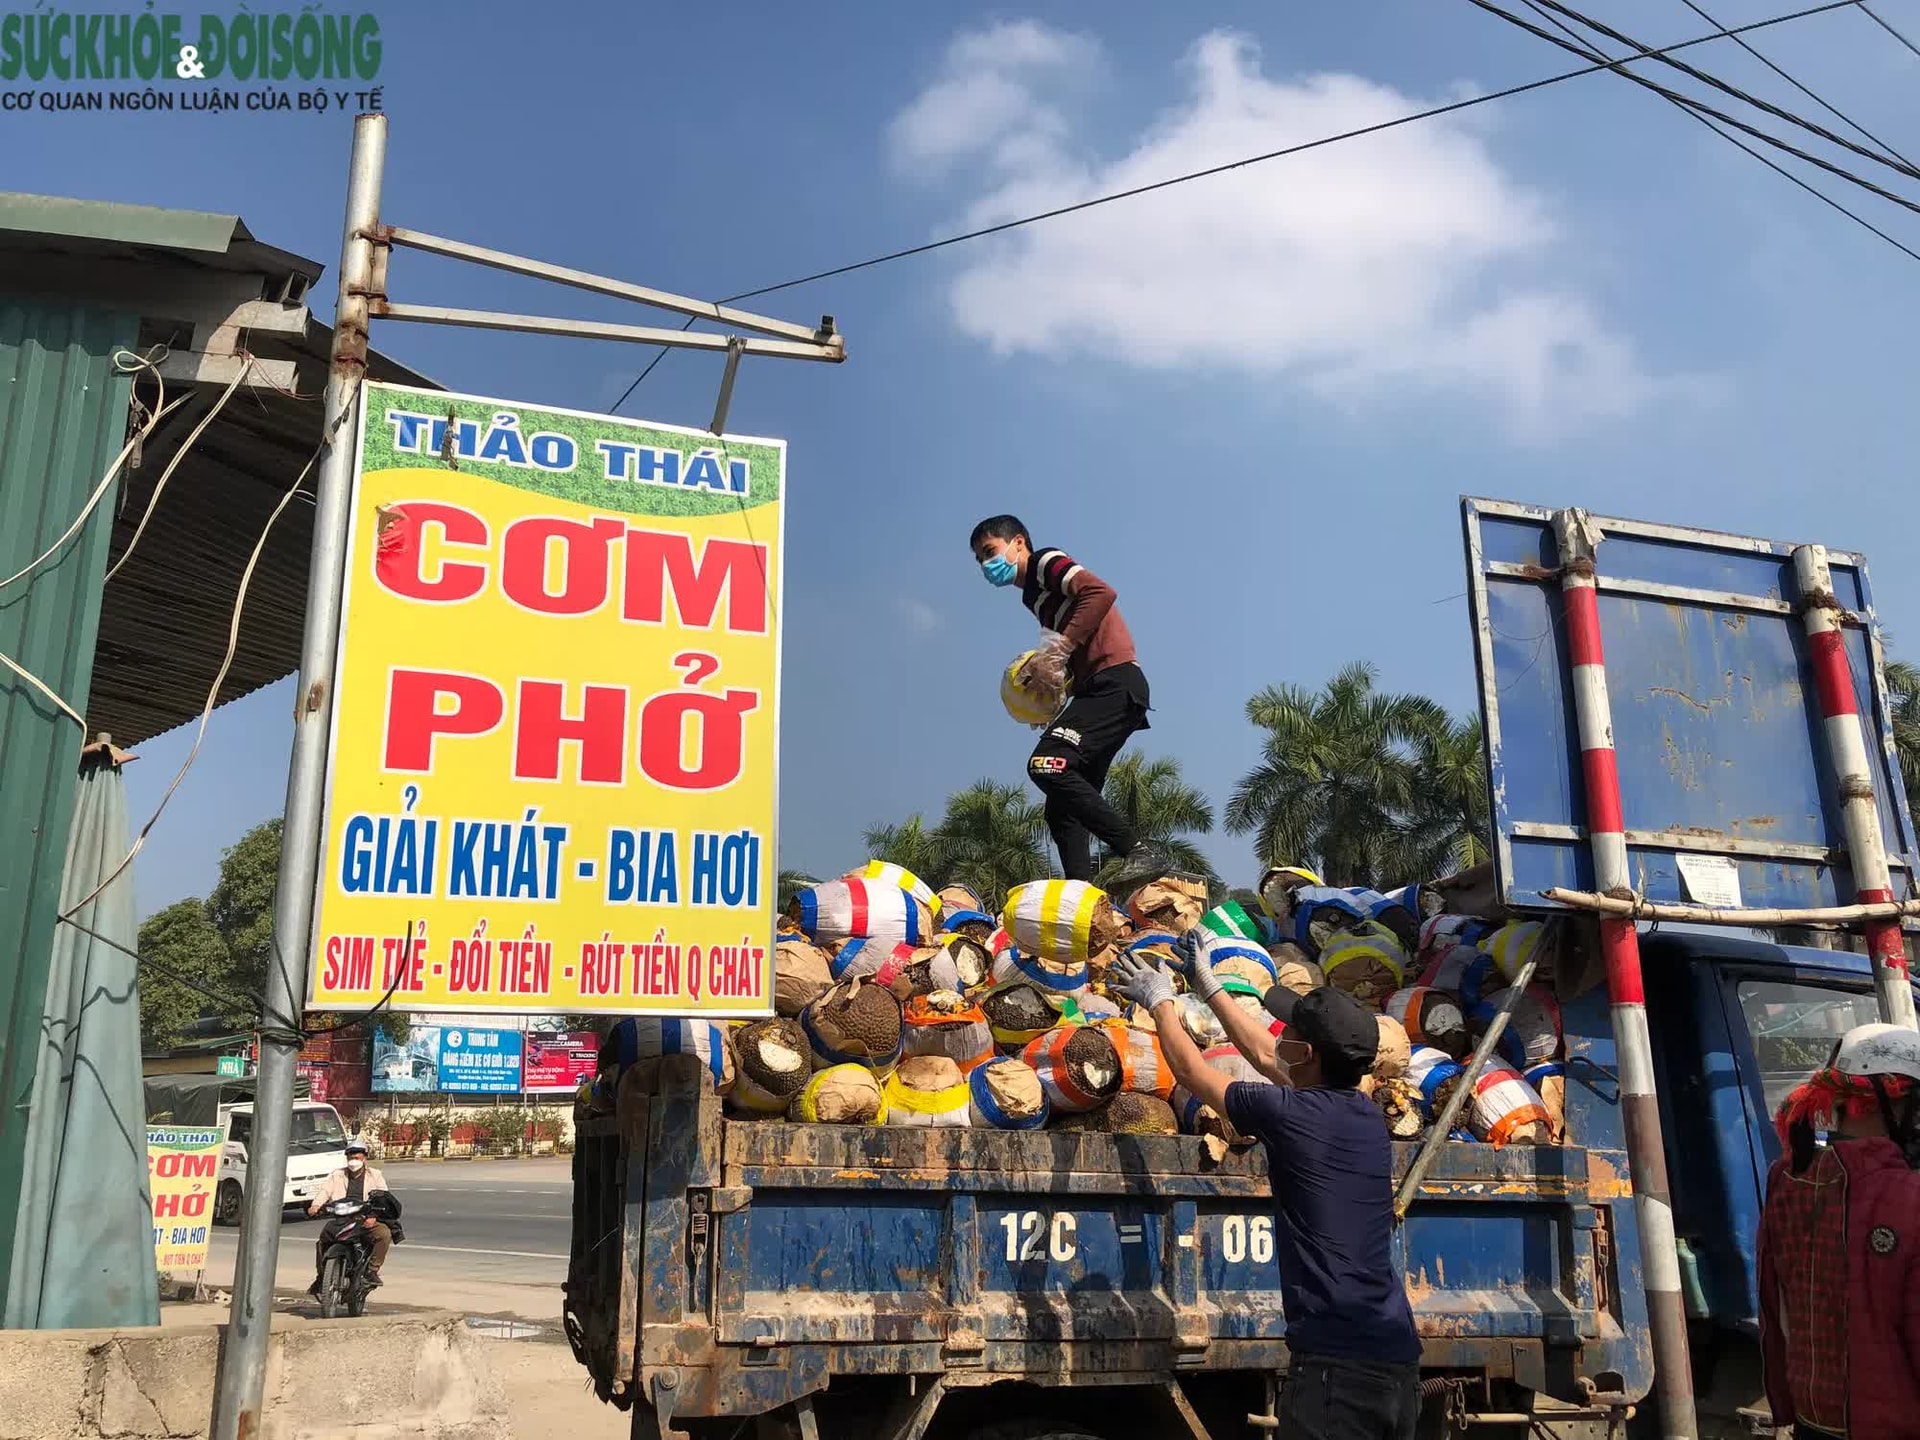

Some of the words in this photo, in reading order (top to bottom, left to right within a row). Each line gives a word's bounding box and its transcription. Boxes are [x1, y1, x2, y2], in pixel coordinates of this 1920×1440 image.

[388, 413, 577, 471] THẢO
[598, 443, 748, 494] THÁI
[375, 501, 768, 634] CƠM
[384, 652, 758, 789] PHỞ
[342, 785, 437, 895] GIẢI
[450, 809, 567, 899] KHÁT
[608, 829, 678, 903] BIA
[692, 830, 759, 906] HƠI
[324, 936, 375, 990] SIM
[382, 920, 427, 991] THẺ
[449, 919, 492, 992] ĐỔI
[499, 924, 551, 993] TIỀN
[580, 932, 625, 994] RÚT
[631, 928, 681, 995] TIỀN
[687, 945, 701, 1001] Q
[709, 936, 764, 997] CHÁT
[182, 1130, 215, 1143] THÁI
[153, 1183, 210, 1218] HỞ
[171, 1227, 187, 1245] BIA
[189, 1226, 206, 1244] HƠI
[1000, 1211, 1077, 1262] 12C
[1222, 1215, 1273, 1264] 06
